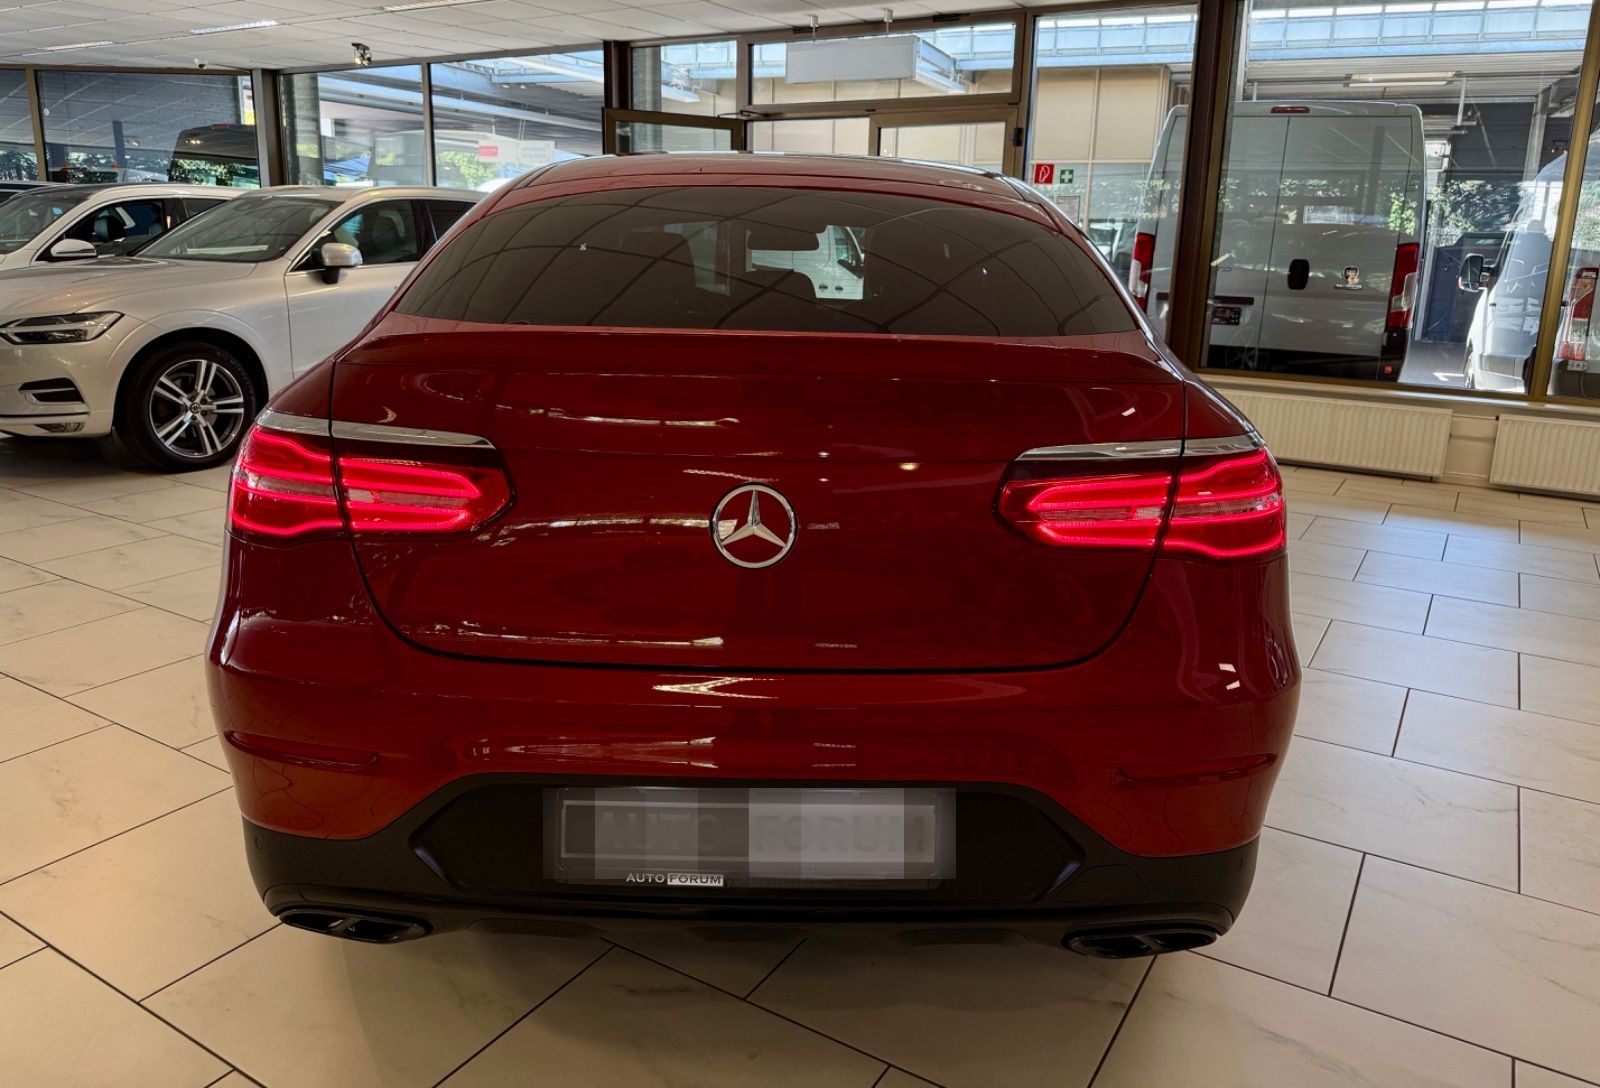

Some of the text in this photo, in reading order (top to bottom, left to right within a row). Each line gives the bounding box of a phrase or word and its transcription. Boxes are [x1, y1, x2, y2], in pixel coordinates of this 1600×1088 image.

[593, 812, 925, 852] AUTO FORUM
[626, 873, 665, 883] AUTO
[669, 874, 721, 884] FORUM
